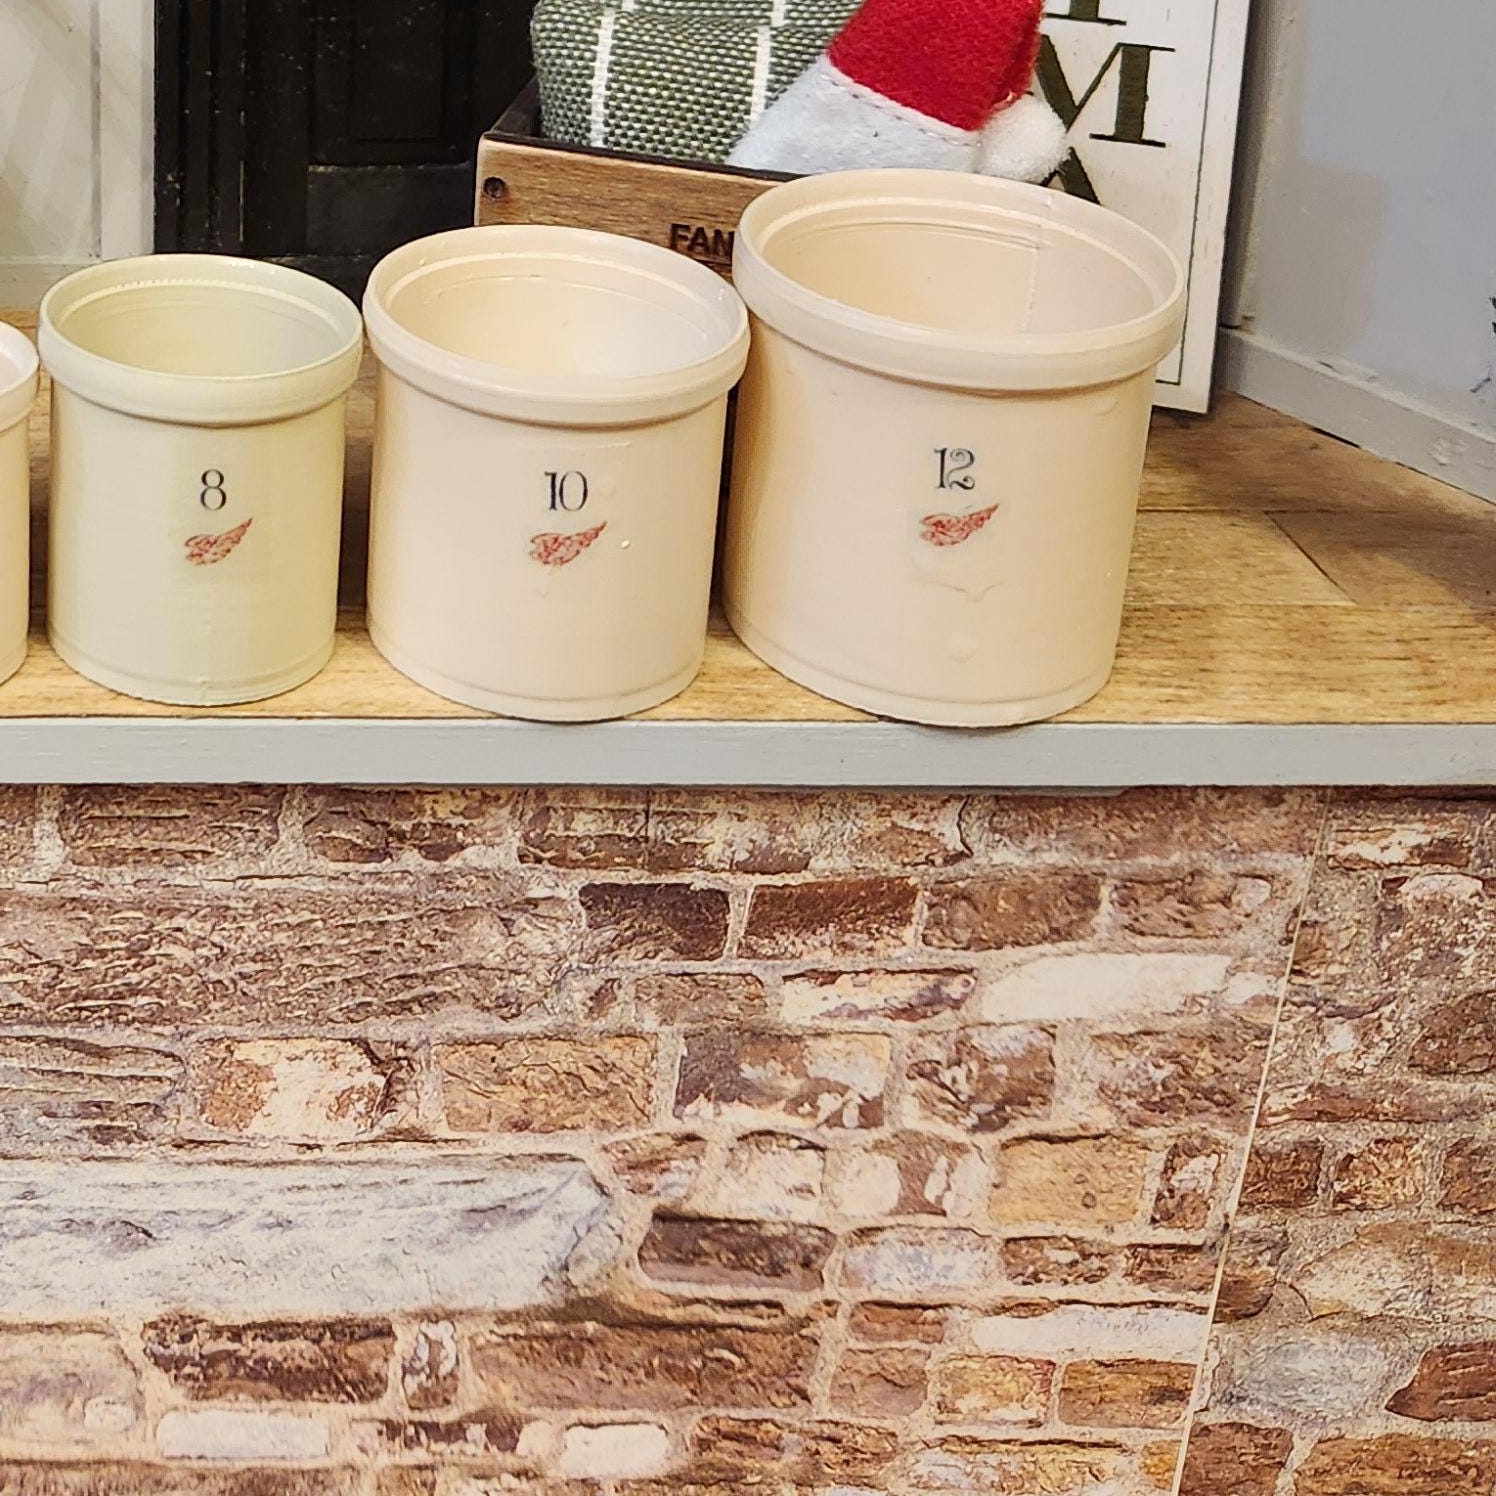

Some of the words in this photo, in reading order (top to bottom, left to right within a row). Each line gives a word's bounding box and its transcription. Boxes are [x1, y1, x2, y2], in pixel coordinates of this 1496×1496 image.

[199, 468, 228, 511] 8
[933, 447, 976, 491] 12
[543, 470, 589, 512] 10
